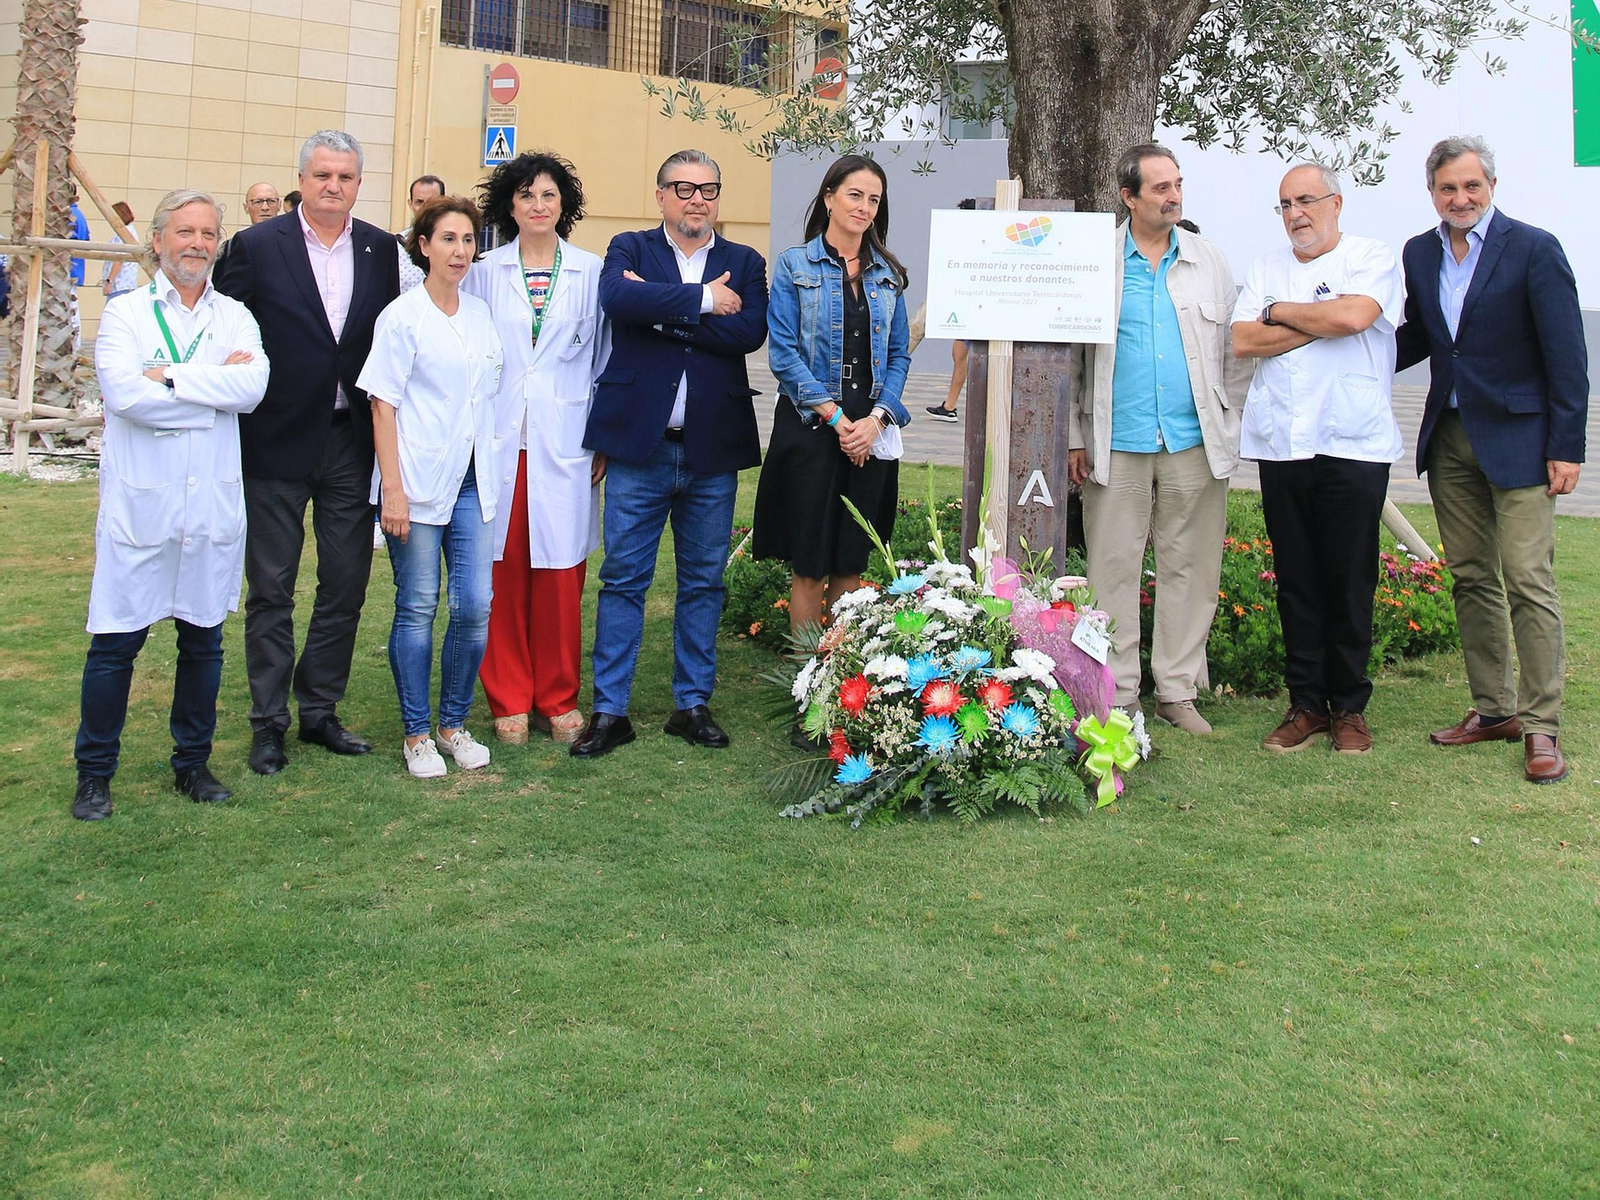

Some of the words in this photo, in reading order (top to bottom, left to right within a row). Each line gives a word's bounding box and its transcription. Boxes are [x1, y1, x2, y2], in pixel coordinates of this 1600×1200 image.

[947, 260, 960, 269] En
[963, 260, 1008, 270] memoria
[1011, 262, 1018, 272] y
[1020, 262, 1100, 272] reconocimiento
[979, 274, 1022, 283] nuestros
[1026, 274, 1075, 284] donantes.
[954, 288, 984, 297] Hospital
[985, 289, 1031, 298] Universitario
[1017, 469, 1055, 507] A
